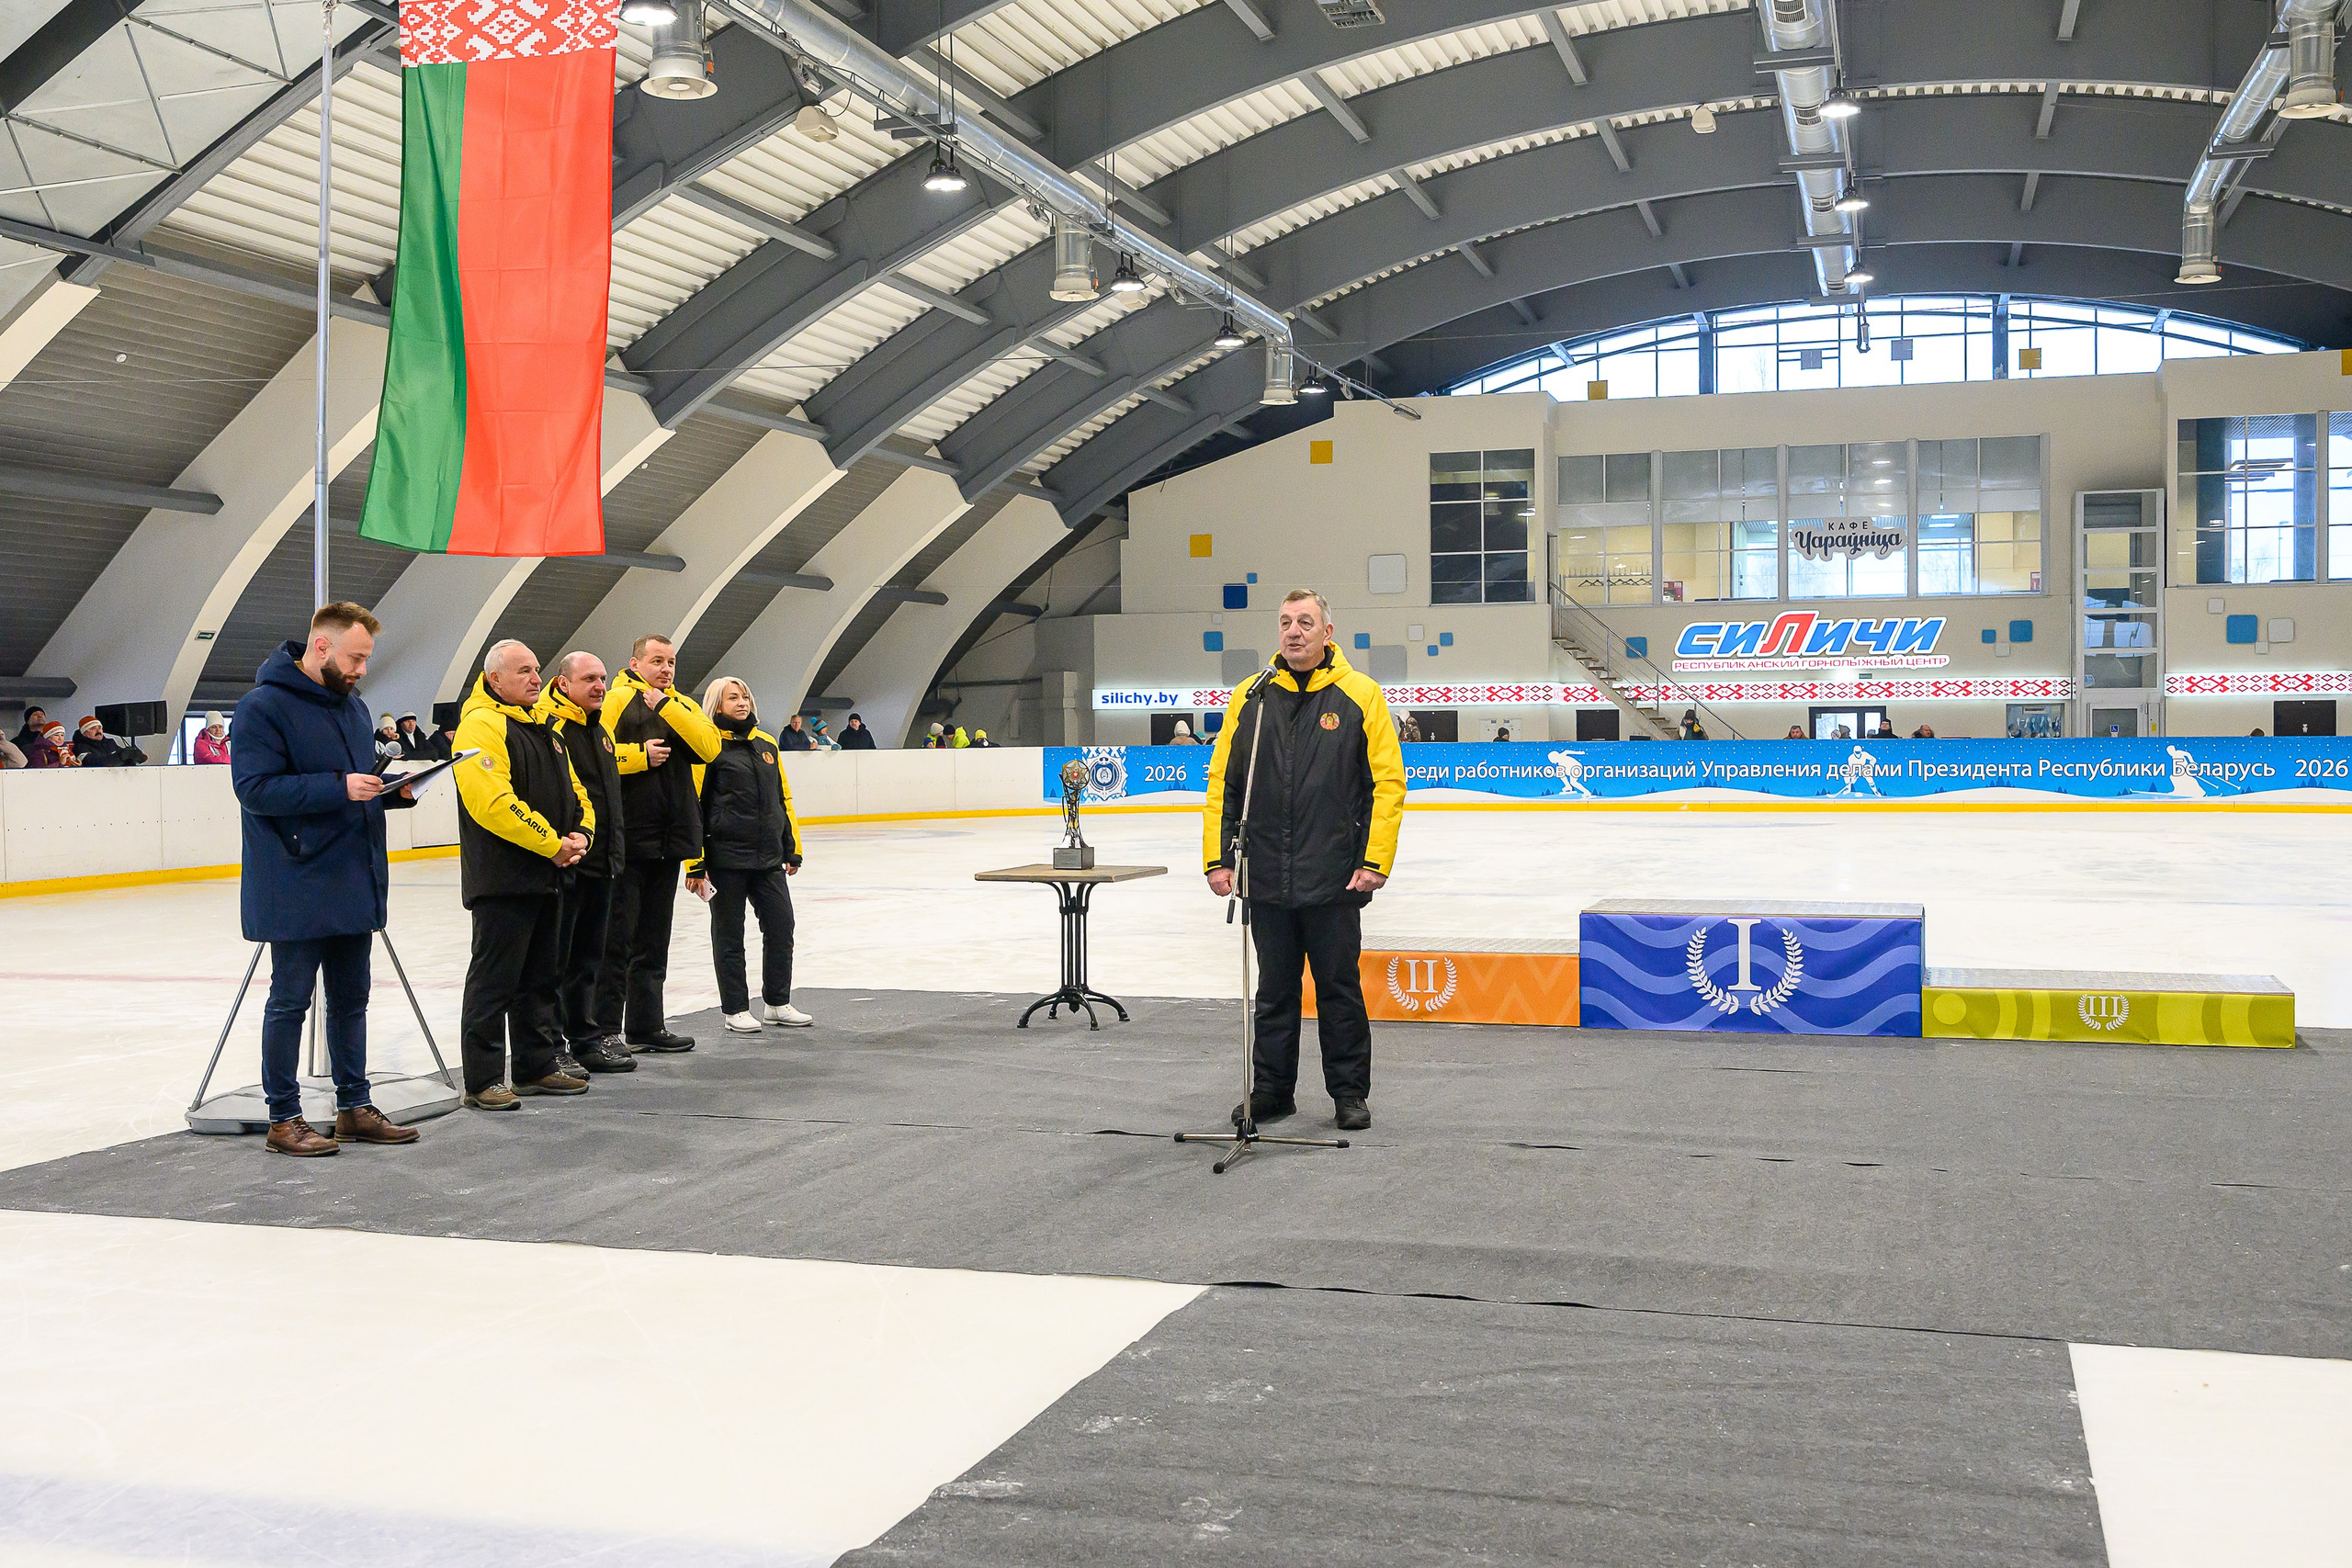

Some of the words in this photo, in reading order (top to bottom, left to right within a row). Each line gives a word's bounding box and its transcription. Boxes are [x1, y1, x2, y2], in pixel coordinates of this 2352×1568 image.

[1828, 521, 1869, 531] КАФЕ
[1794, 531, 1903, 557] Чараўніца
[1674, 659, 1800, 670] РЕСПУБЛИКАНСКИЙ
[1802, 657, 1904, 668] ГОРНОЛЫЖНЫЙ
[1906, 657, 1947, 668] ЦЕНТР
[1101, 692, 1179, 705] silichy.by
[1144, 764, 1187, 782] 2026
[1404, 765, 1450, 783] реди
[1454, 761, 1566, 783] работников
[1569, 760, 1697, 783] организаций
[1701, 760, 1821, 782] Управления
[1826, 763, 1903, 781] делами
[1908, 760, 2032, 782] Президента
[2039, 758, 2165, 782] Республики
[2172, 758, 2276, 782] Беларусь
[2294, 759, 2349, 778] 2026
[509, 803, 548, 838] BELARUS
[1726, 918, 1762, 991] I
[1405, 959, 1439, 993] II
[2086, 996, 2121, 1017] III
